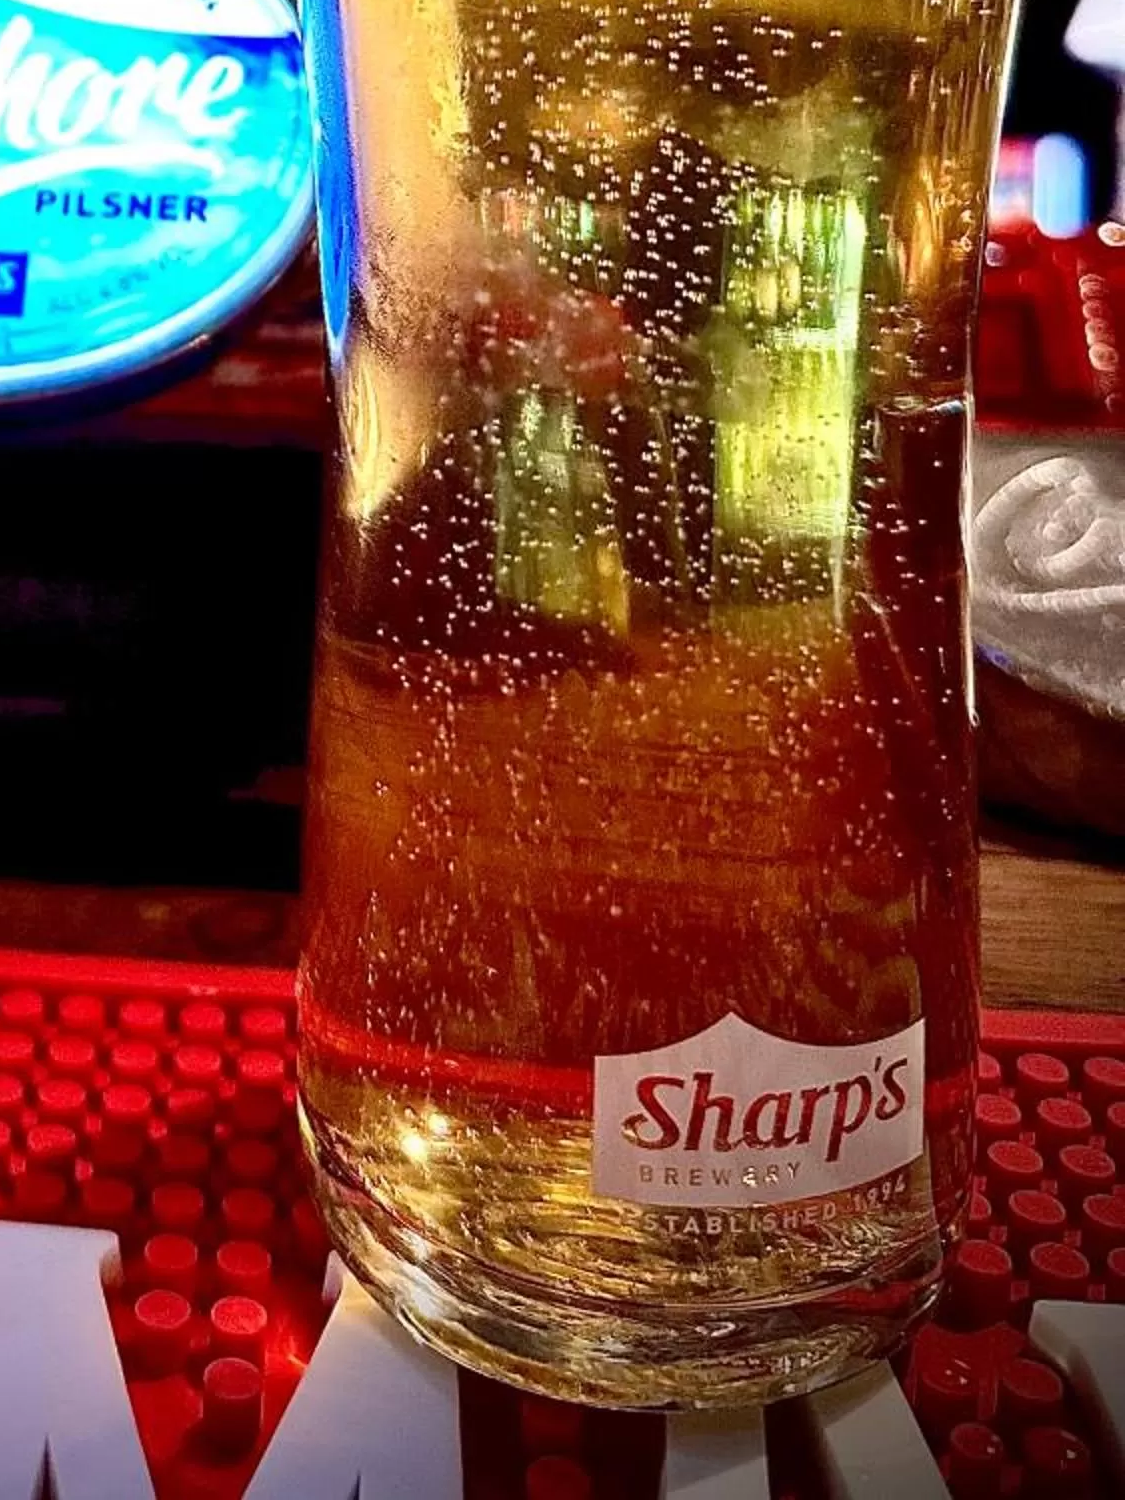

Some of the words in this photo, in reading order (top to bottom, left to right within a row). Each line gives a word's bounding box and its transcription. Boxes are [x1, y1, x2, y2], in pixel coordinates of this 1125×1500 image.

[35, 189, 209, 222] PILSNER
[621, 1056, 908, 1163] Sharp's
[639, 1161, 801, 1189] BREWERY
[628, 1202, 837, 1236] ESTABLISHED
